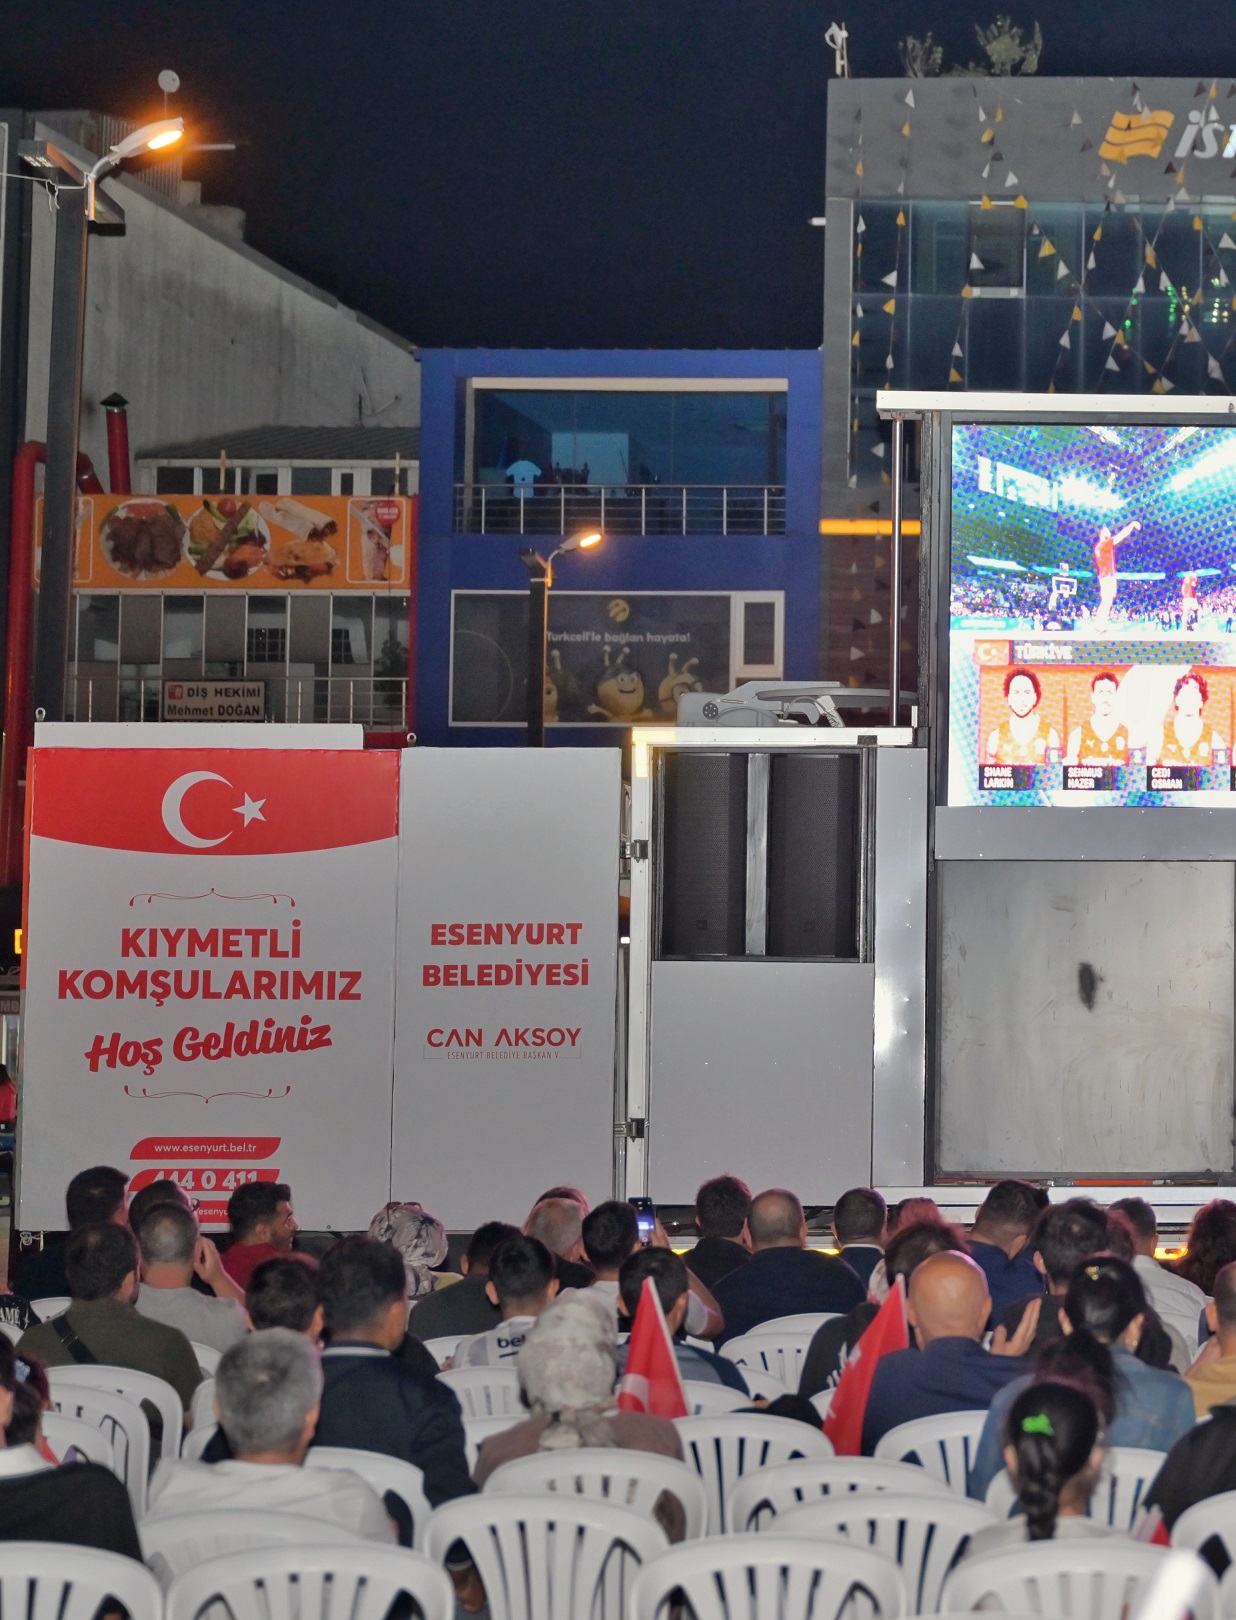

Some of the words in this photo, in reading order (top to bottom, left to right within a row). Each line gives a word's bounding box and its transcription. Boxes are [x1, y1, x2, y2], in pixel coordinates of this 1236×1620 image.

[167, 704, 214, 717] Mehmet
[218, 703, 260, 717] DOĞAN
[983, 767, 1013, 778] SHANE
[1151, 767, 1171, 778] CEDI
[983, 778, 1014, 789] LARKIN
[1067, 778, 1095, 789] HAZER
[1151, 778, 1182, 790] OSMAN
[120, 919, 302, 959] KIYMETLİ
[431, 922, 583, 946] ESENYURT
[422, 958, 589, 987] BELEDİYESİ
[57, 969, 362, 1007] KOMŞULARIMIZ
[426, 1028, 483, 1048] CAN
[494, 1027, 582, 1047] AKSOY
[84, 1032, 164, 1076] Hoş
[173, 1014, 333, 1062] Geldiniz
[447, 1051, 484, 1060] ESENYURT
[486, 1050, 520, 1060] BELEDİYE
[523, 1051, 552, 1061] BAŞKAN
[154, 1142, 257, 1154] www.esenyurt.bel.tr
[201, 1170, 217, 1190] 0
